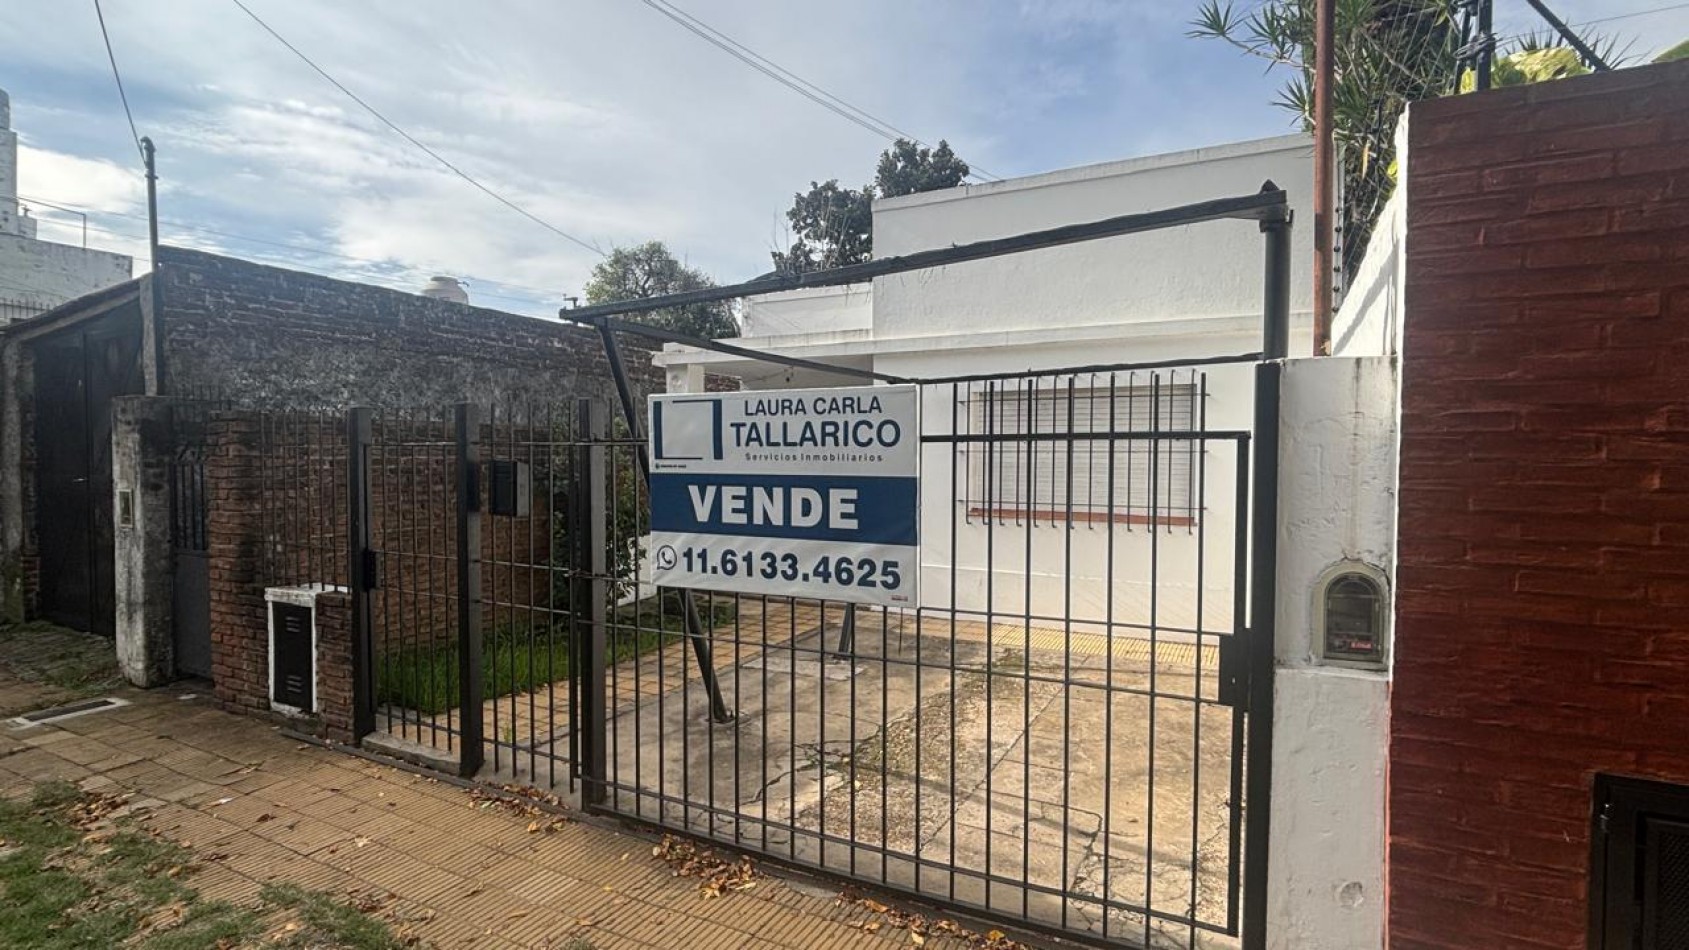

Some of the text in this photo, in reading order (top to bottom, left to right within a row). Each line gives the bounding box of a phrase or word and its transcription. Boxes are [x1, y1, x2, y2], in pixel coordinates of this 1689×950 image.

[744, 396, 882, 416] LAURA CARLA
[730, 419, 901, 448] TALLARICO
[745, 452, 884, 463] Servicios Inmobiliarios
[688, 484, 859, 530] VENDE
[682, 546, 901, 590] 11.6133.4625
